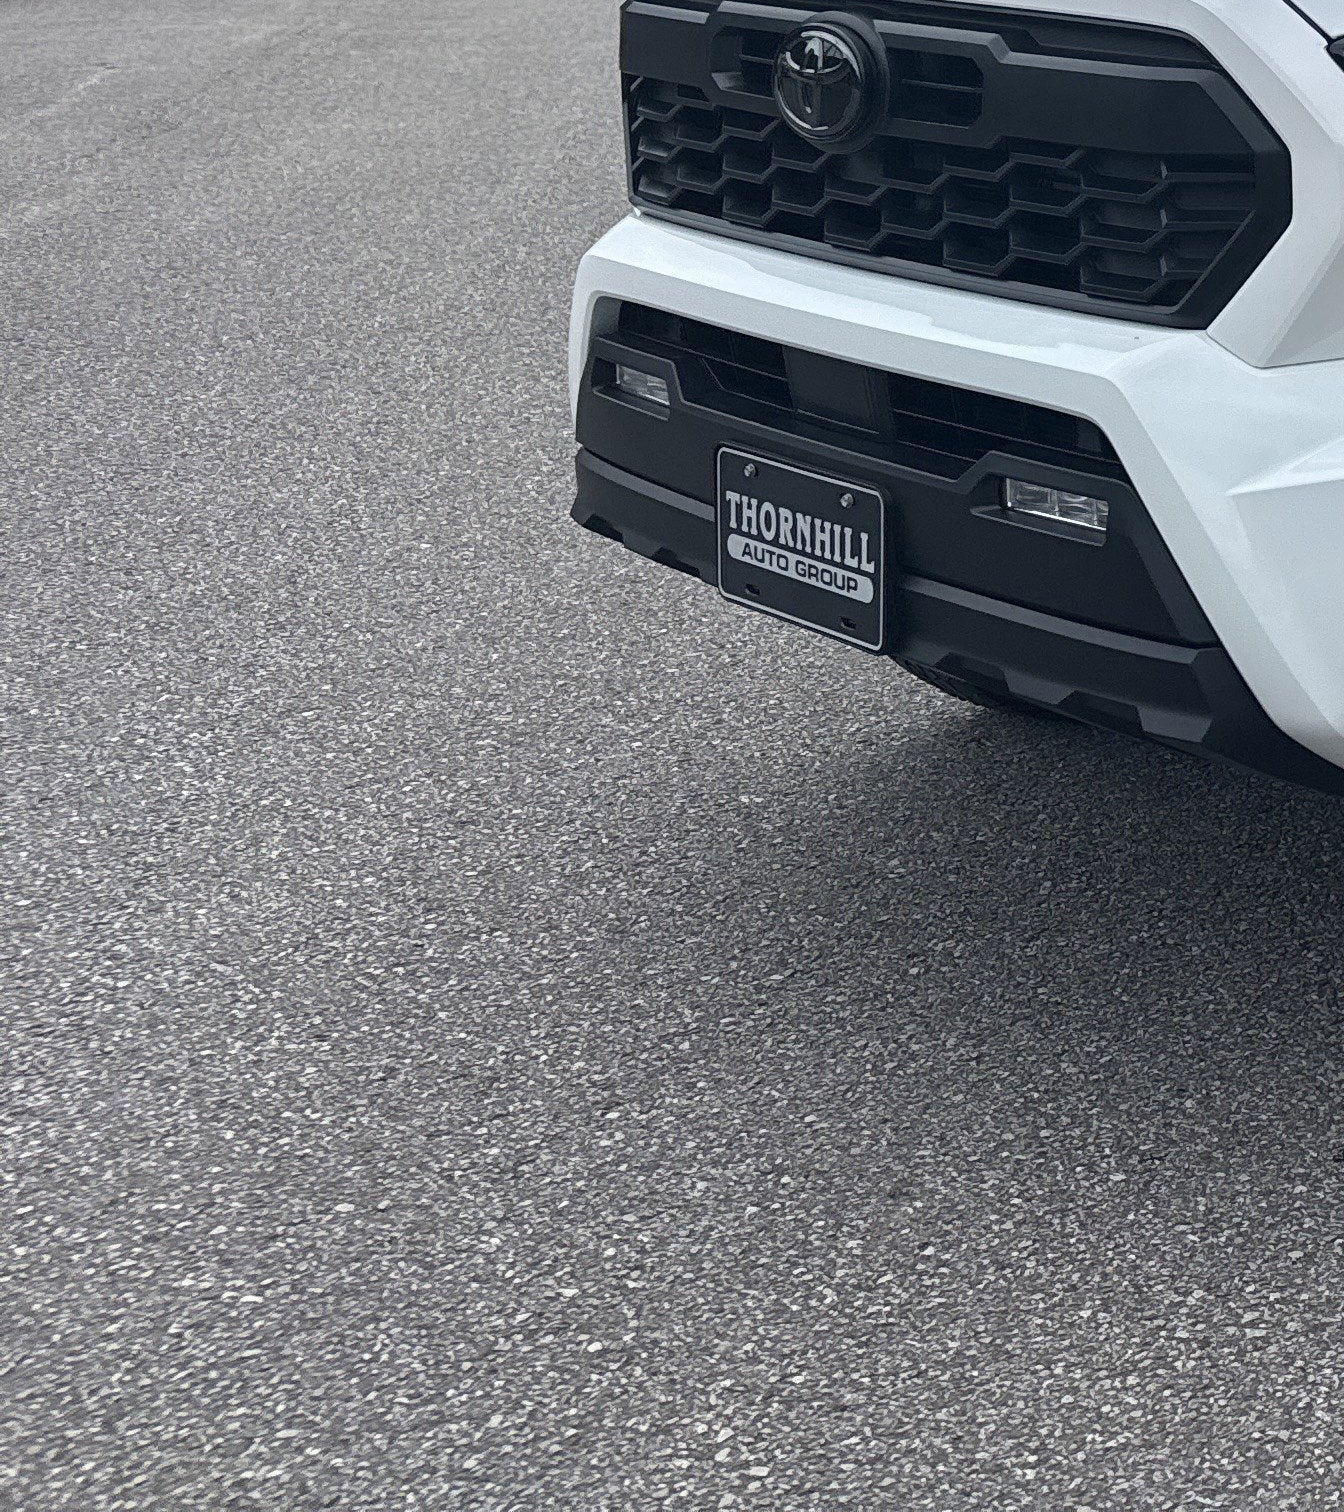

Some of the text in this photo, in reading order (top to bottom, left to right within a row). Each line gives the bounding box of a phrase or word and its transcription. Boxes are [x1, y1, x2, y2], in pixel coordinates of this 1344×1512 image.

[726, 490, 875, 573] THORNHILL
[742, 542, 859, 592] AUTO GROUP
